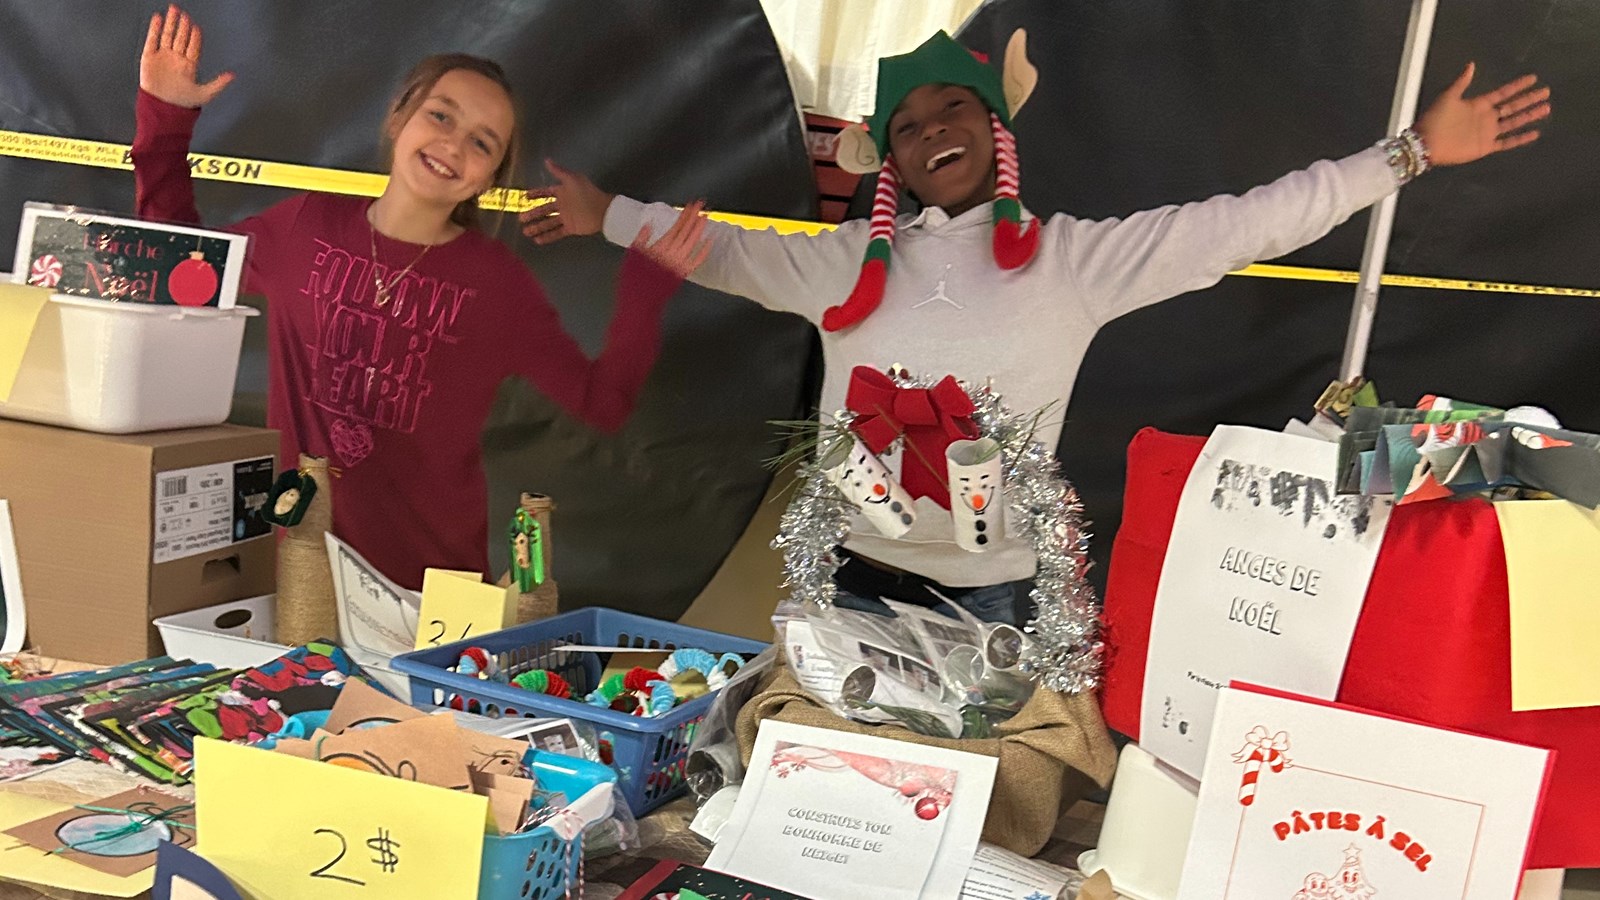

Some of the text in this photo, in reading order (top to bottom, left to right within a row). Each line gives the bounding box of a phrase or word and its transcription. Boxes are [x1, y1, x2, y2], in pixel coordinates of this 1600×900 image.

[1219, 546, 1323, 597] ANGES DE
[1228, 596, 1282, 636] NOËL
[781, 824, 884, 854] BONHOMME DE
[787, 806, 893, 836] CONSTRUIS TON
[1273, 810, 1432, 873] PÂTES À SEL
